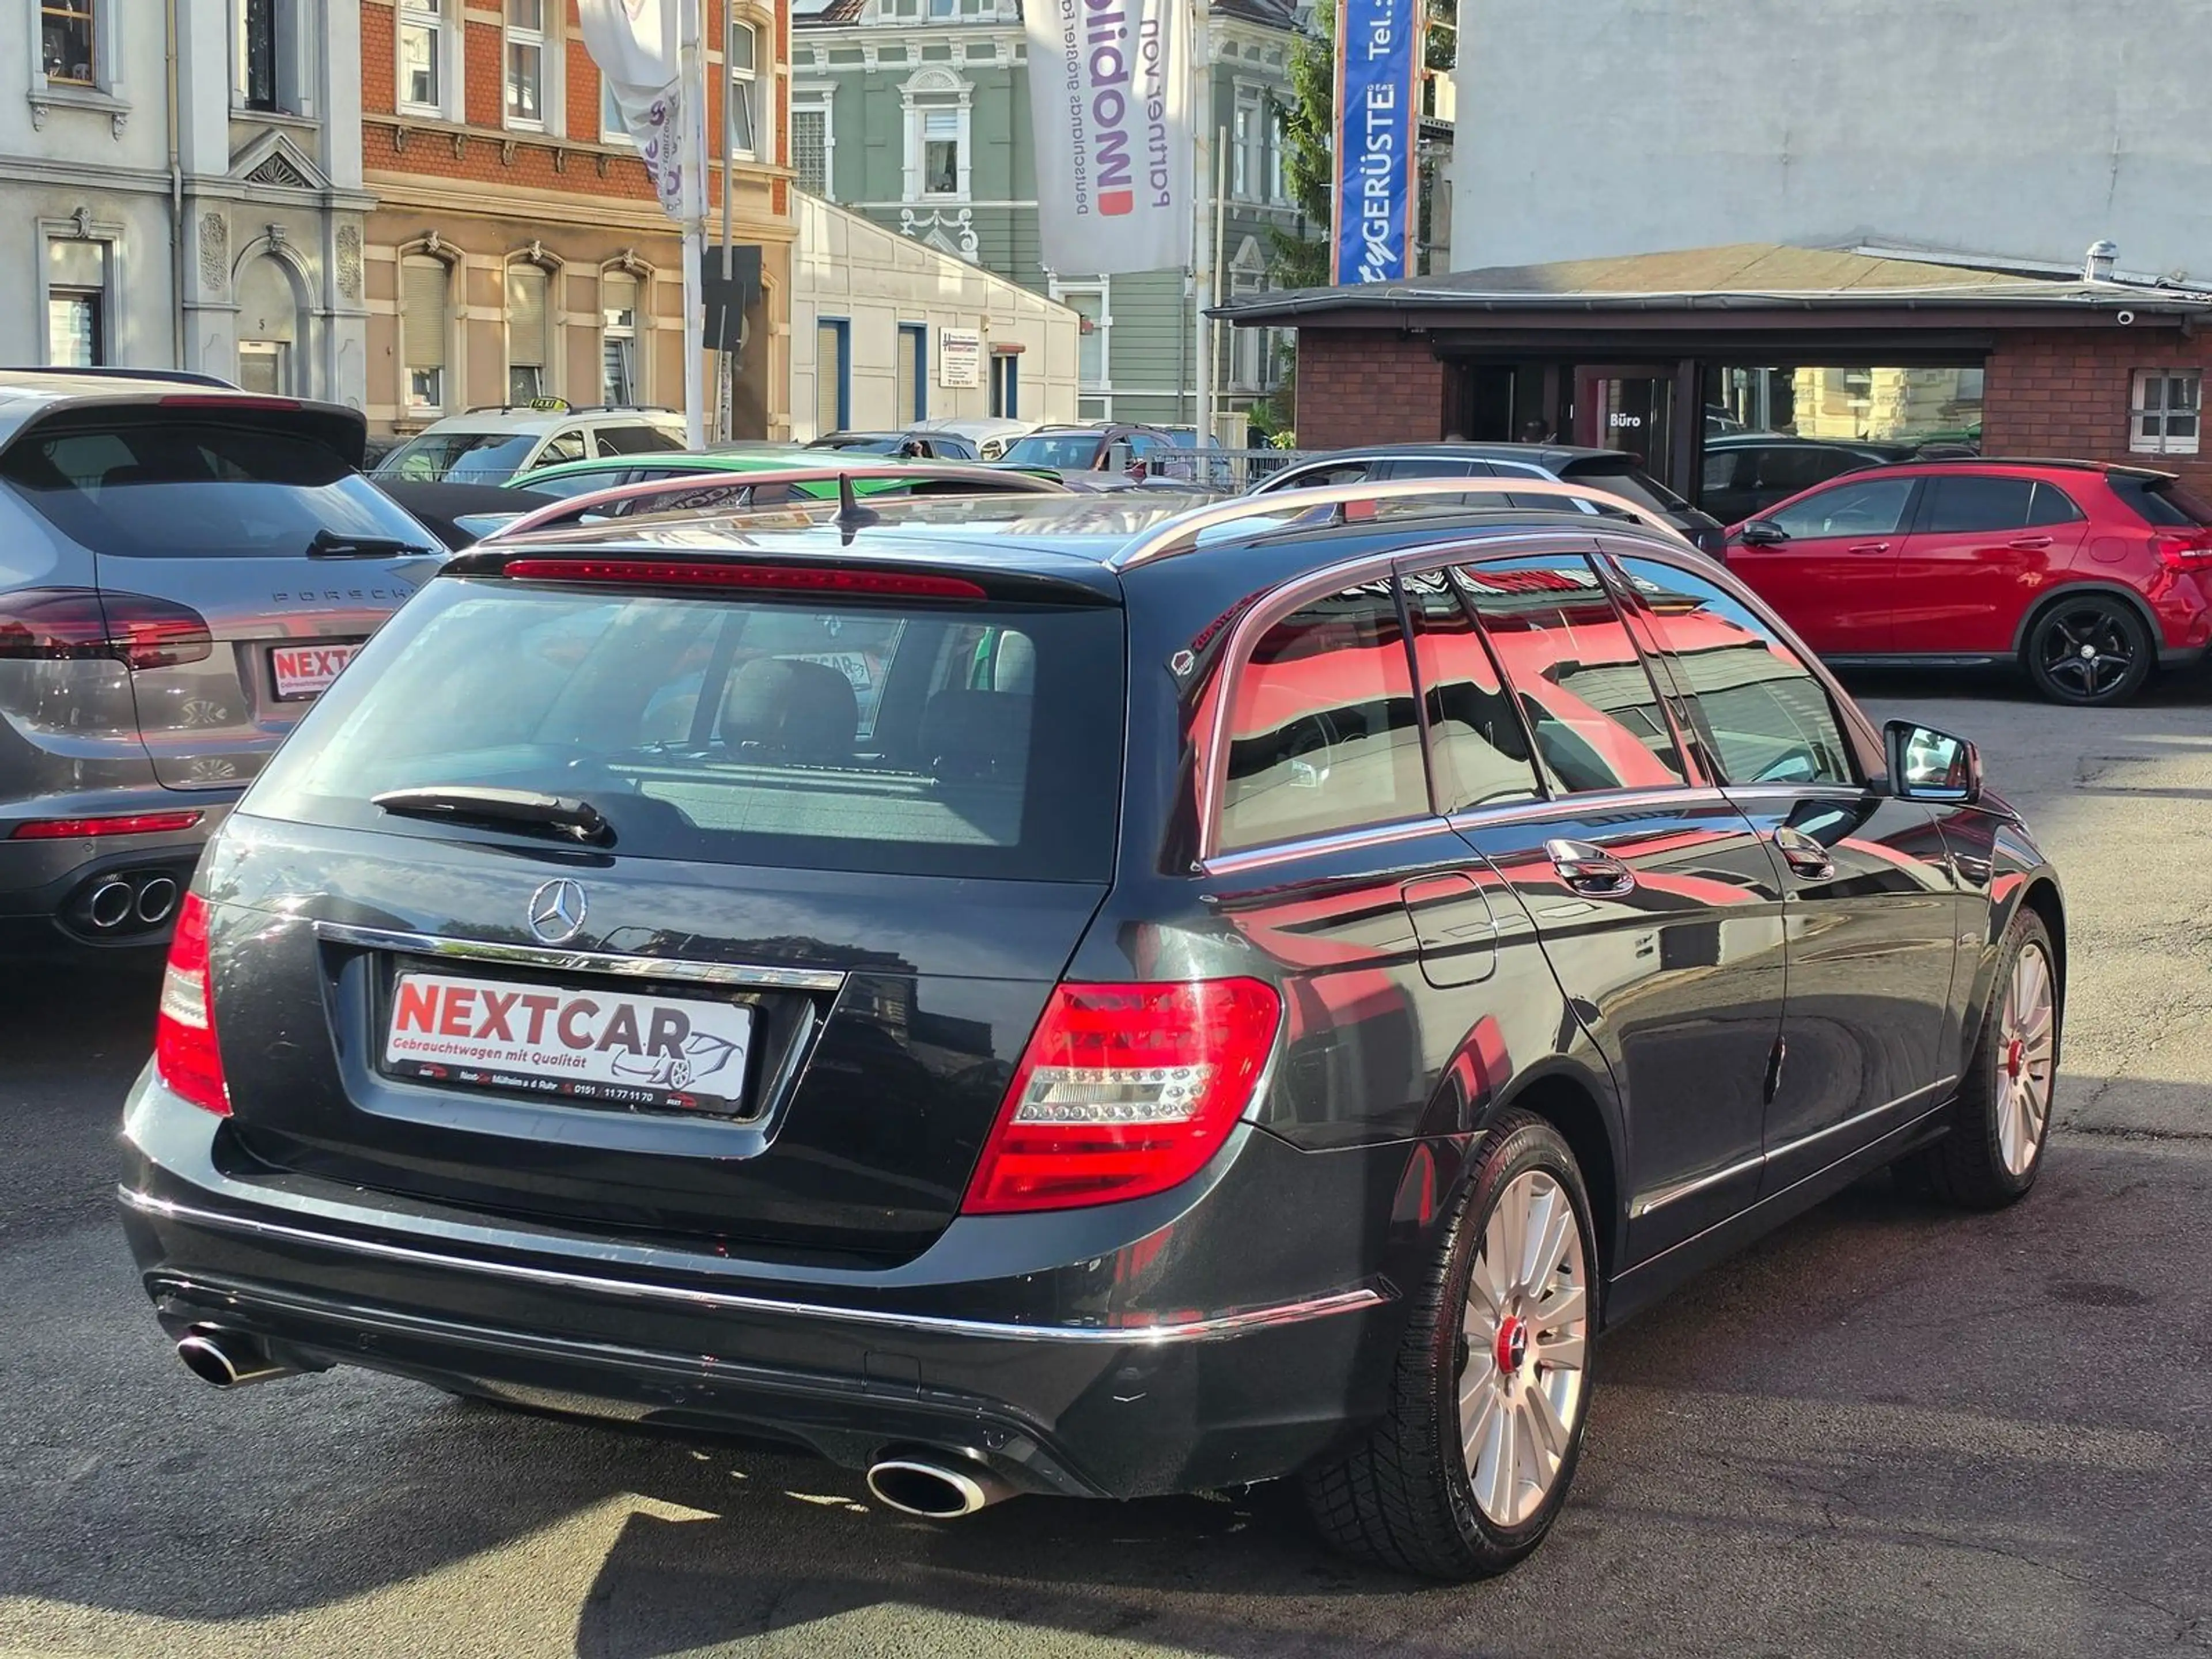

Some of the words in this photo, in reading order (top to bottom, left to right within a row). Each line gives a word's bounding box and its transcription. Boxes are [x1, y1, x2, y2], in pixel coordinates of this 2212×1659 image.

[1610, 412, 1641, 427] Büro
[272, 588, 416, 603] PORSCH
[396, 982, 690, 1060] NEXTCAR
[393, 1037, 502, 1060] Gebrauchtwagen
[506, 1048, 528, 1062] mit
[532, 1052, 586, 1069] Qualität
